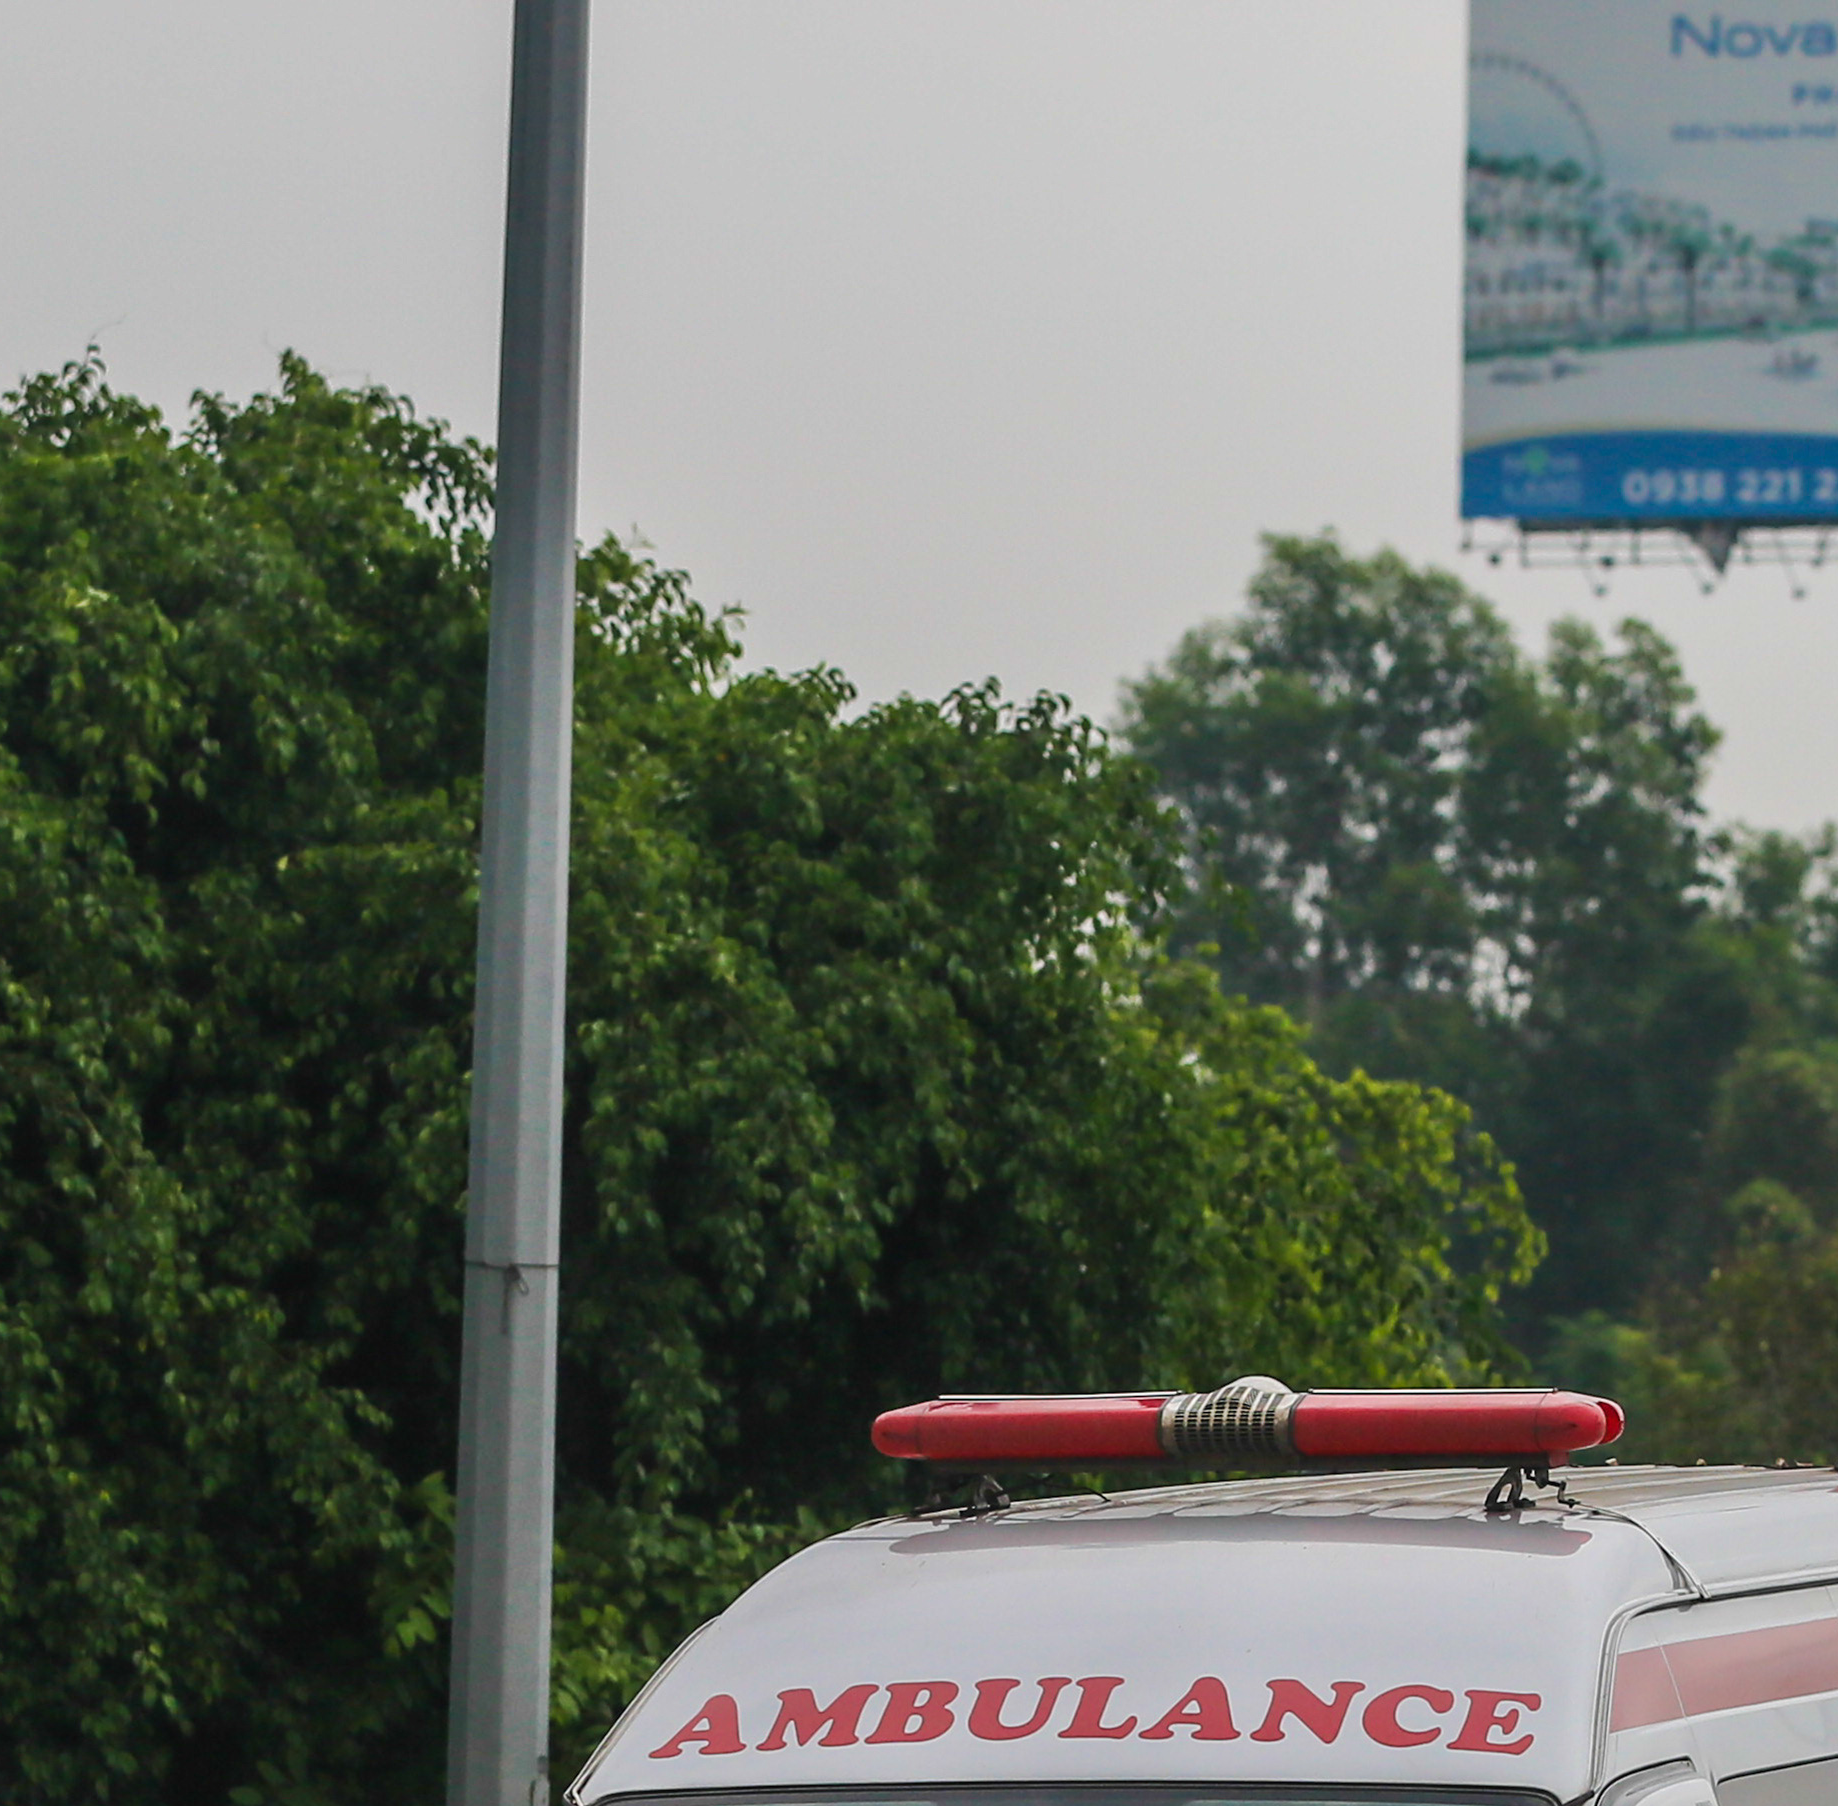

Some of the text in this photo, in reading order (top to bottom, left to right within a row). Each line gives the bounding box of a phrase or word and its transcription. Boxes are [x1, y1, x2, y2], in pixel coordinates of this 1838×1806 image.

[1622, 468, 1723, 504] 0938
[1735, 467, 1802, 503] 221
[648, 1675, 1542, 1760] AMBULANCE
